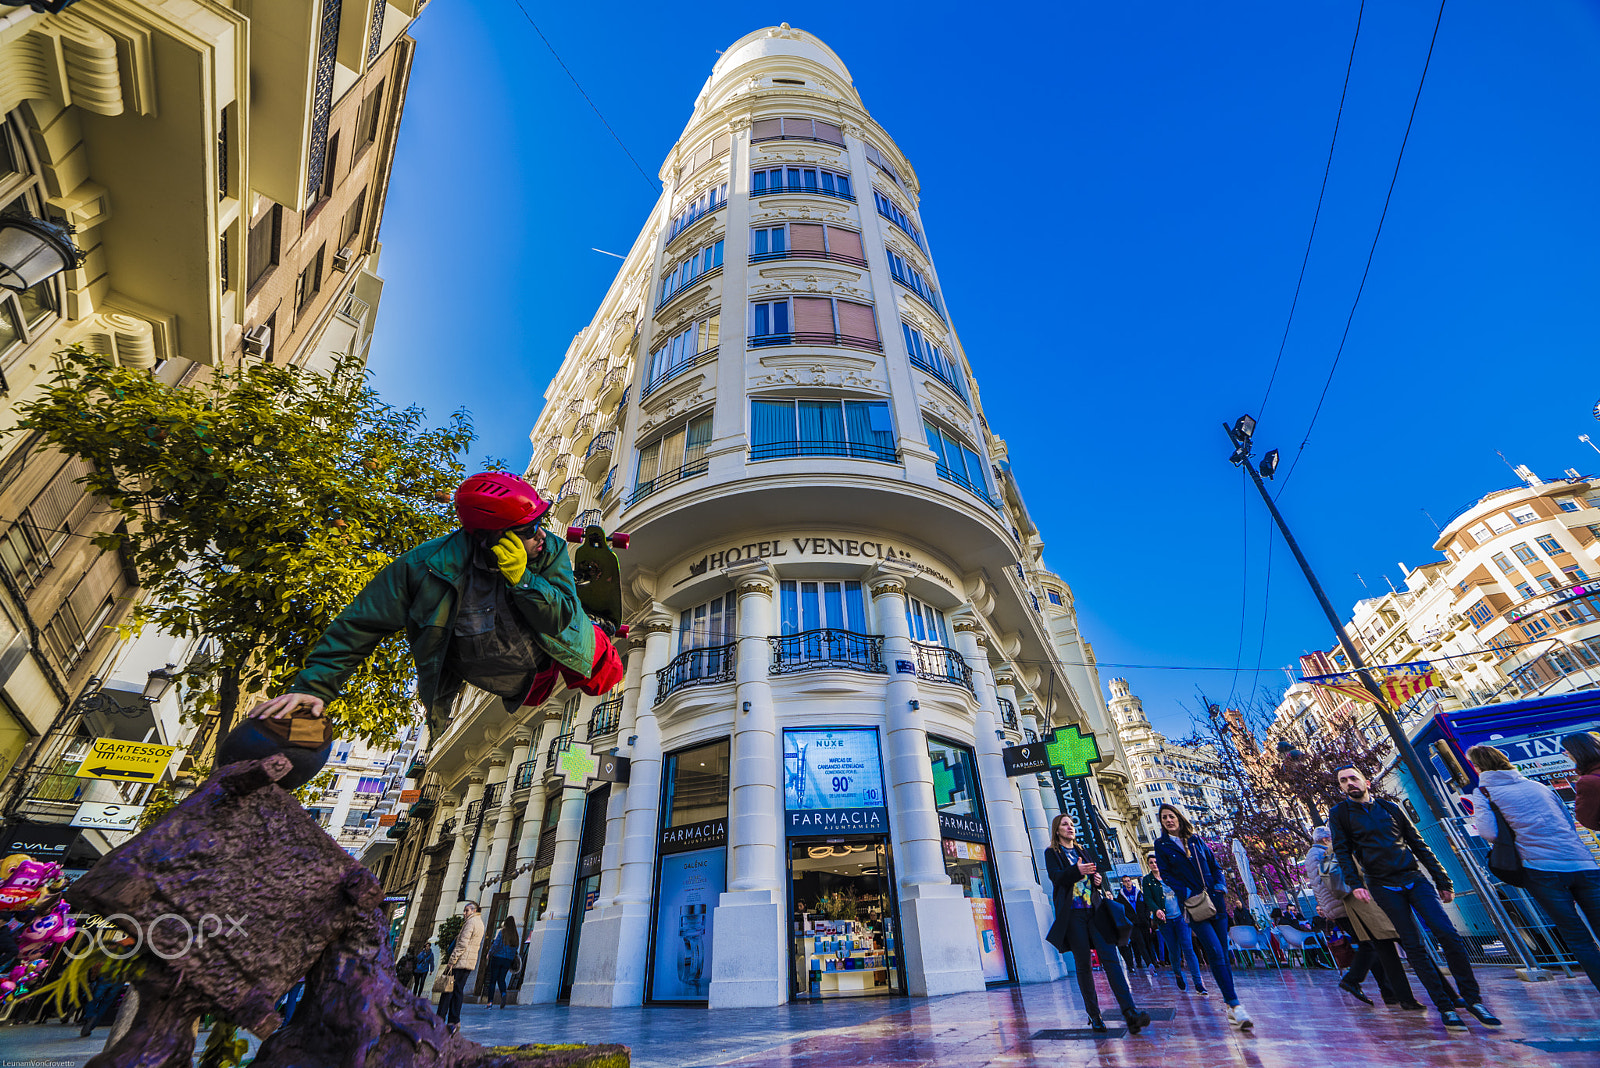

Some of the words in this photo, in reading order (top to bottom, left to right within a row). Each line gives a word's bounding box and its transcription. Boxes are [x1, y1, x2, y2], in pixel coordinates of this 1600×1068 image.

[709, 540, 788, 570] HOTEL
[792, 537, 897, 560] VENECIA
[1562, 580, 1600, 599] HOTE
[99, 742, 174, 758] TARTESSOS
[816, 740, 844, 748] NUXE
[1515, 734, 1568, 758] TAX
[116, 755, 152, 764] HOSTAL
[1012, 760, 1044, 769] FARMACIA
[1520, 761, 1538, 771] AXI
[792, 811, 880, 826] FARMACIA
[939, 815, 985, 834] FARMACIA
[663, 822, 725, 844] FARMACIA
[684, 834, 724, 845] AJUNTAMENT
[11, 842, 69, 851] OVALE
